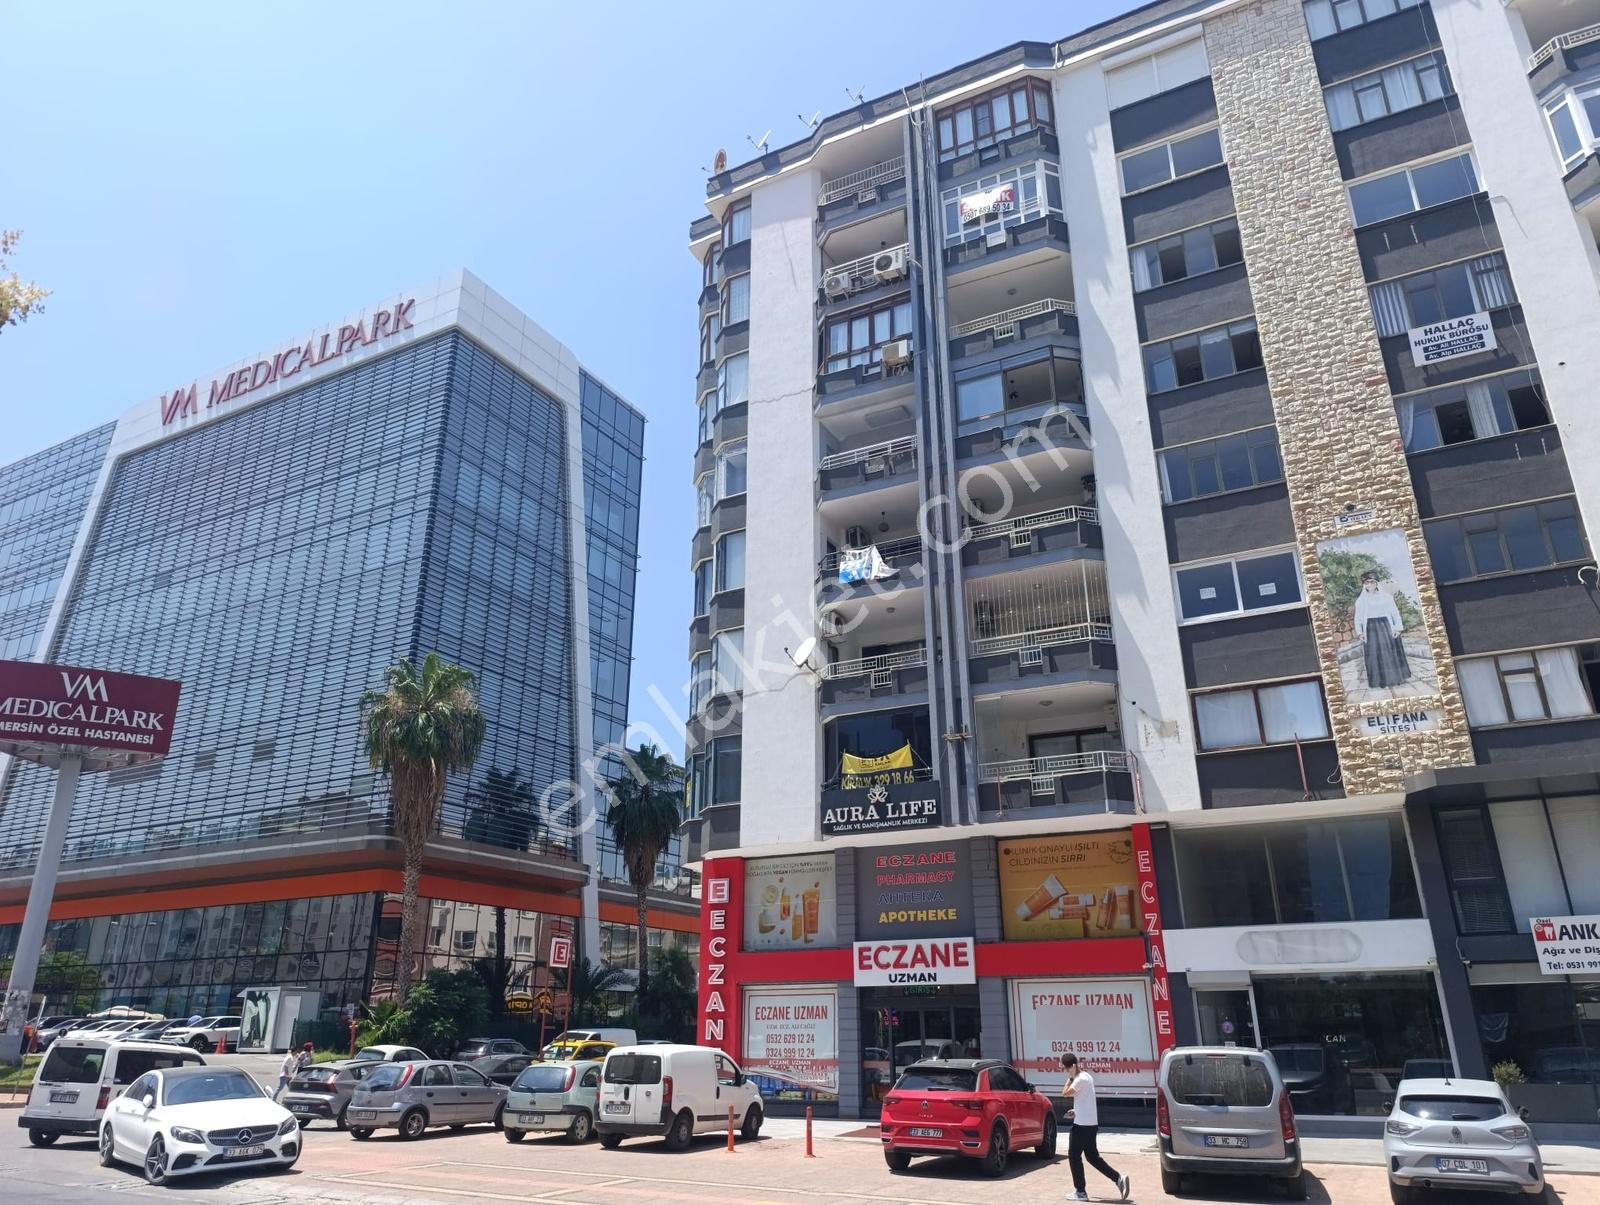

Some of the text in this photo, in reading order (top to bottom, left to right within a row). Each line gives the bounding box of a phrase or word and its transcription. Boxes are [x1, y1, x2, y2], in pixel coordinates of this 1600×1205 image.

[1414, 333, 1447, 347] HUKUK
[160, 382, 198, 426] VM
[61, 671, 109, 703] VM
[47, 722, 81, 737] ÖZEL
[84, 728, 154, 745] HASTANESİ
[874, 774, 890, 787] 329
[891, 772, 902, 785] 18
[903, 769, 915, 784] 66
[823, 799, 937, 824] AURA LIFE
[861, 819, 901, 829] DANIŞMANLIK
[875, 851, 957, 868] ECZANE
[876, 870, 956, 887] PHARMACY
[879, 908, 957, 924] APOTHEKE
[1138, 850, 1171, 1035] ECZANE
[857, 941, 969, 971] ECZANE
[1543, 947, 1566, 956] Ağız
[1547, 962, 1564, 970] Tel:
[1566, 961, 1585, 969] 0531
[704, 909, 727, 1049] ECZAN
[888, 972, 937, 983] UZMAN
[755, 1005, 828, 1021] ECZANE UZMAN
[766, 1033, 815, 1043] 0532 629 12 24
[766, 1048, 815, 1058] 0324 999 12 24
[1051, 1041, 1121, 1052] 0324 999 12 24
[1471, 1160, 1485, 1169] 101
